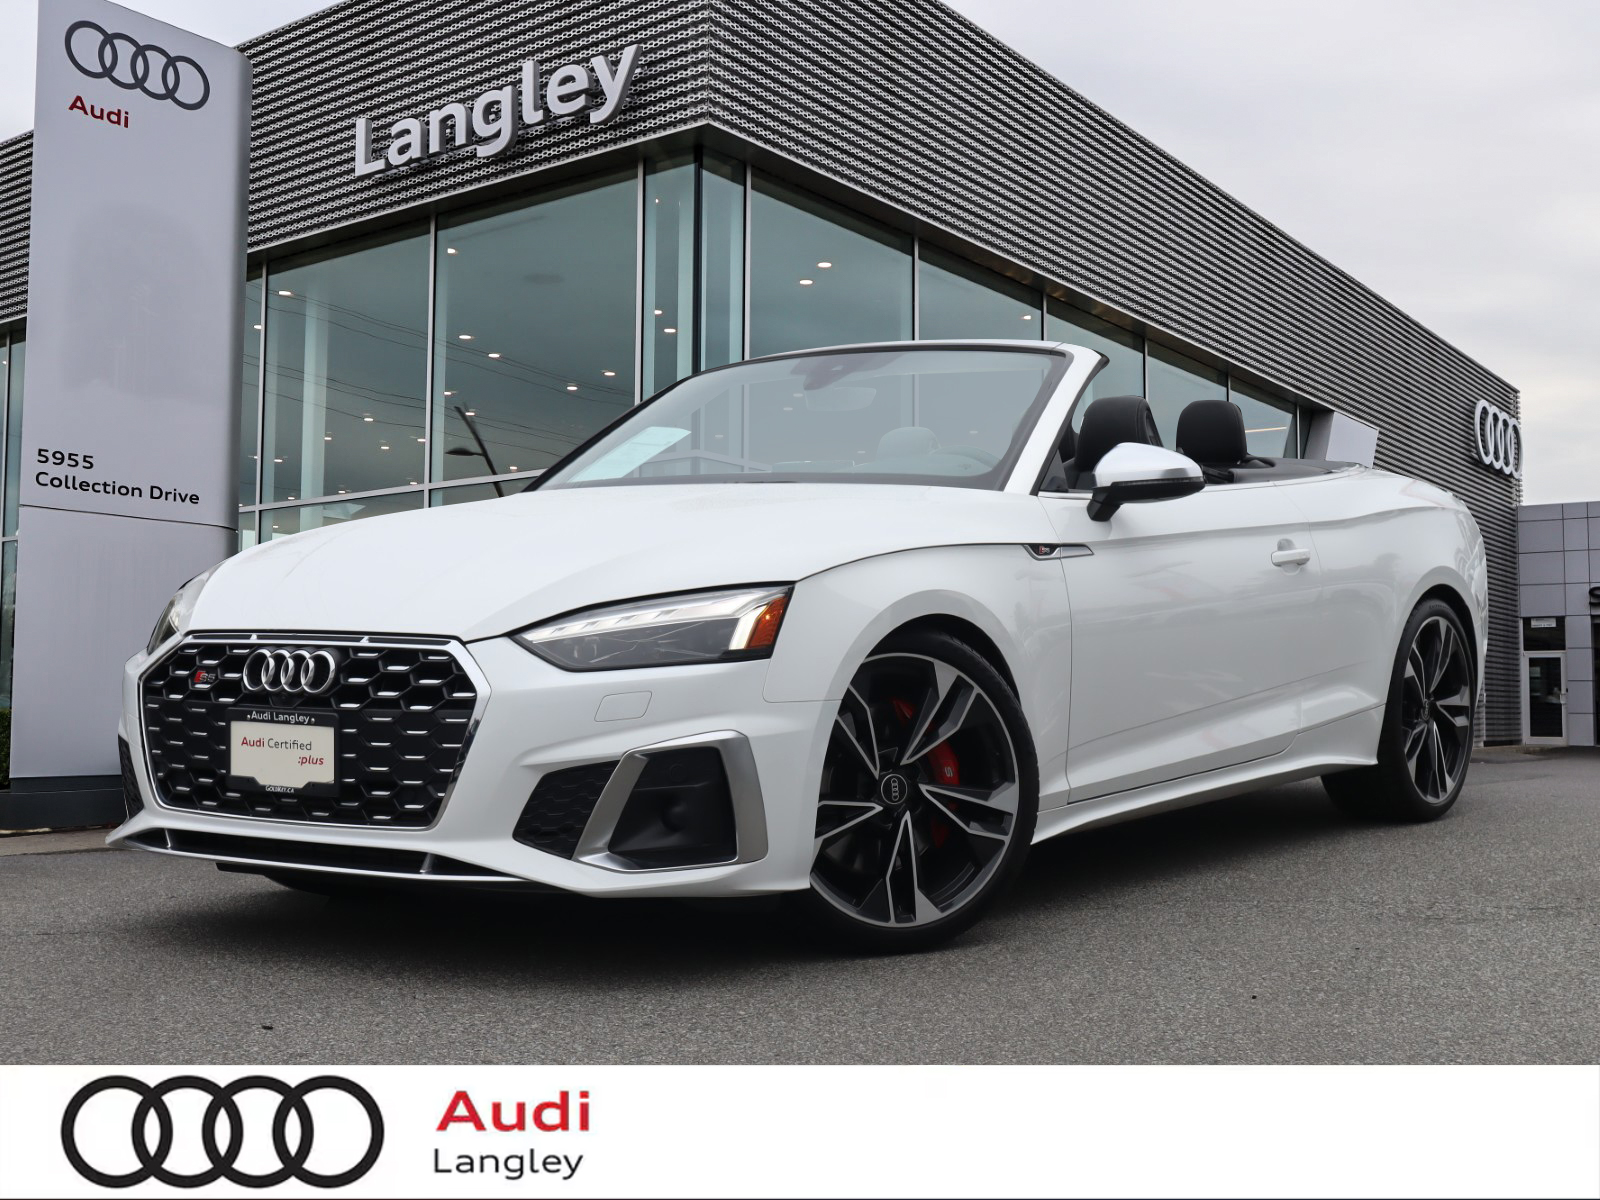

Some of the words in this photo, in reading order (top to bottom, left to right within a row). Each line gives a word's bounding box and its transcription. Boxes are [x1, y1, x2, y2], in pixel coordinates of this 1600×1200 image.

[68, 95, 130, 129] Audi
[355, 44, 643, 177] Langley
[36, 448, 94, 470] 5955
[35, 471, 143, 498] Collection
[149, 485, 200, 504] Drive
[250, 711, 271, 721] Audi
[273, 712, 310, 724] Langley
[241, 737, 265, 748] Audi
[267, 738, 312, 751] Certified
